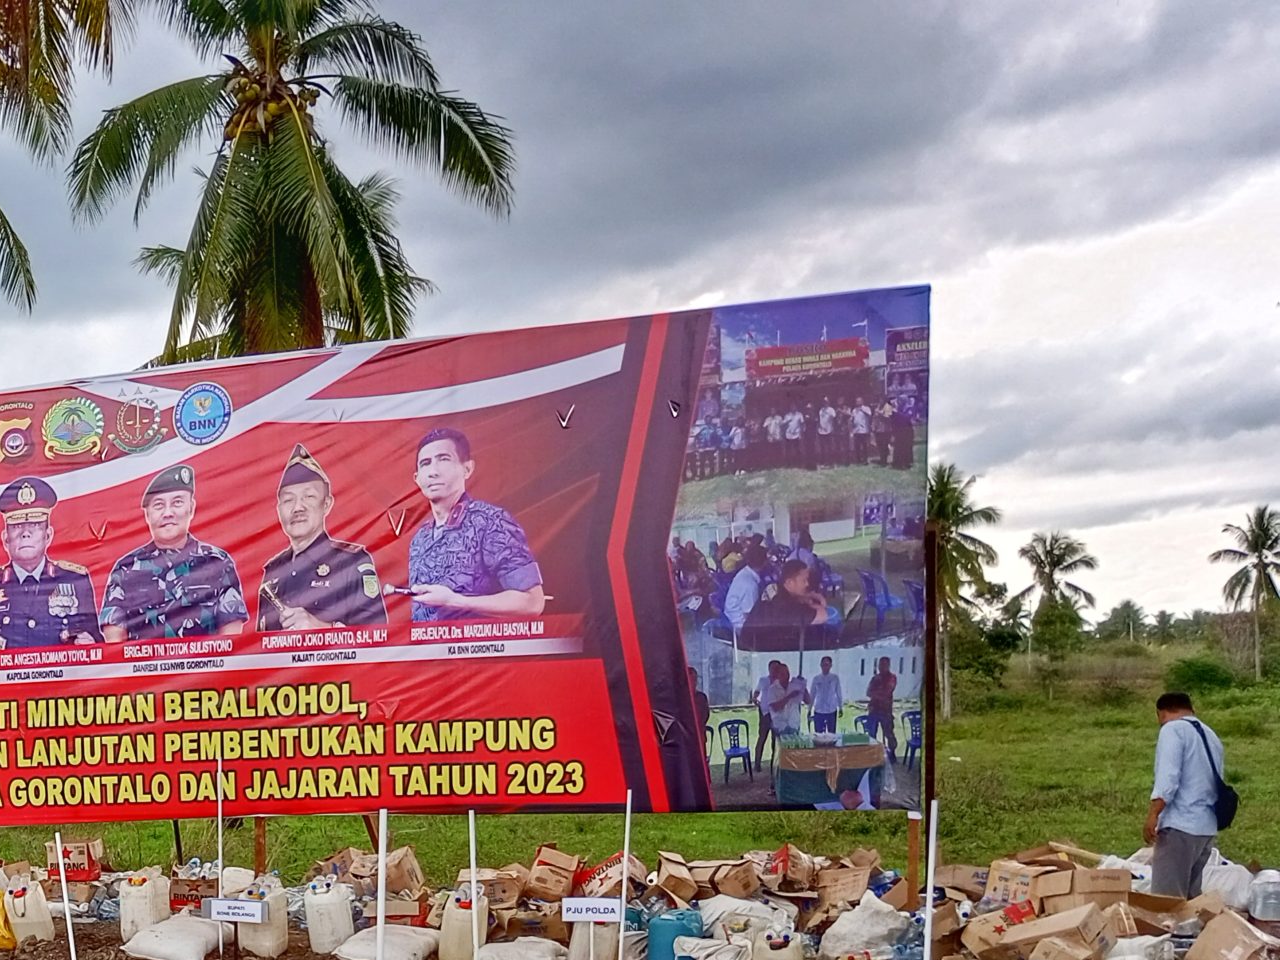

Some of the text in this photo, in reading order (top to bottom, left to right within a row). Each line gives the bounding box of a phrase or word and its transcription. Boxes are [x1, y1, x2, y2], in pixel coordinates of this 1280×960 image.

[189, 419, 216, 431] BNN
[492, 623, 503, 637] ALI
[262, 634, 302, 649] PURWANTO
[303, 632, 324, 646] JOKO
[324, 631, 356, 646] IRIANTO,
[123, 639, 233, 658] BRIGJEN TNI TOTOK SULISTYONO
[447, 643, 504, 655] KA BNN GORONTALO
[14, 652, 42, 665] ANGESTA
[291, 651, 356, 663] KAJATI GORONTALO
[132, 663, 159, 673] DANREM
[186, 659, 224, 670] GORONTALO
[6, 669, 64, 681] KAPOLDA GORONTALO
[26, 692, 155, 728] MINUMAN
[163, 682, 368, 721] BERALKOHOL,
[15, 731, 155, 767] LANJUTAN
[164, 723, 385, 762] PEMBENTUKAN
[394, 717, 556, 753] KAMPUNG
[9, 773, 171, 807] GORONTALO
[179, 770, 237, 801] DAN
[245, 766, 380, 800] JAJARAN
[389, 763, 497, 796] TAHUN
[507, 761, 585, 794] 2023
[565, 906, 616, 915] PJU POLDA
